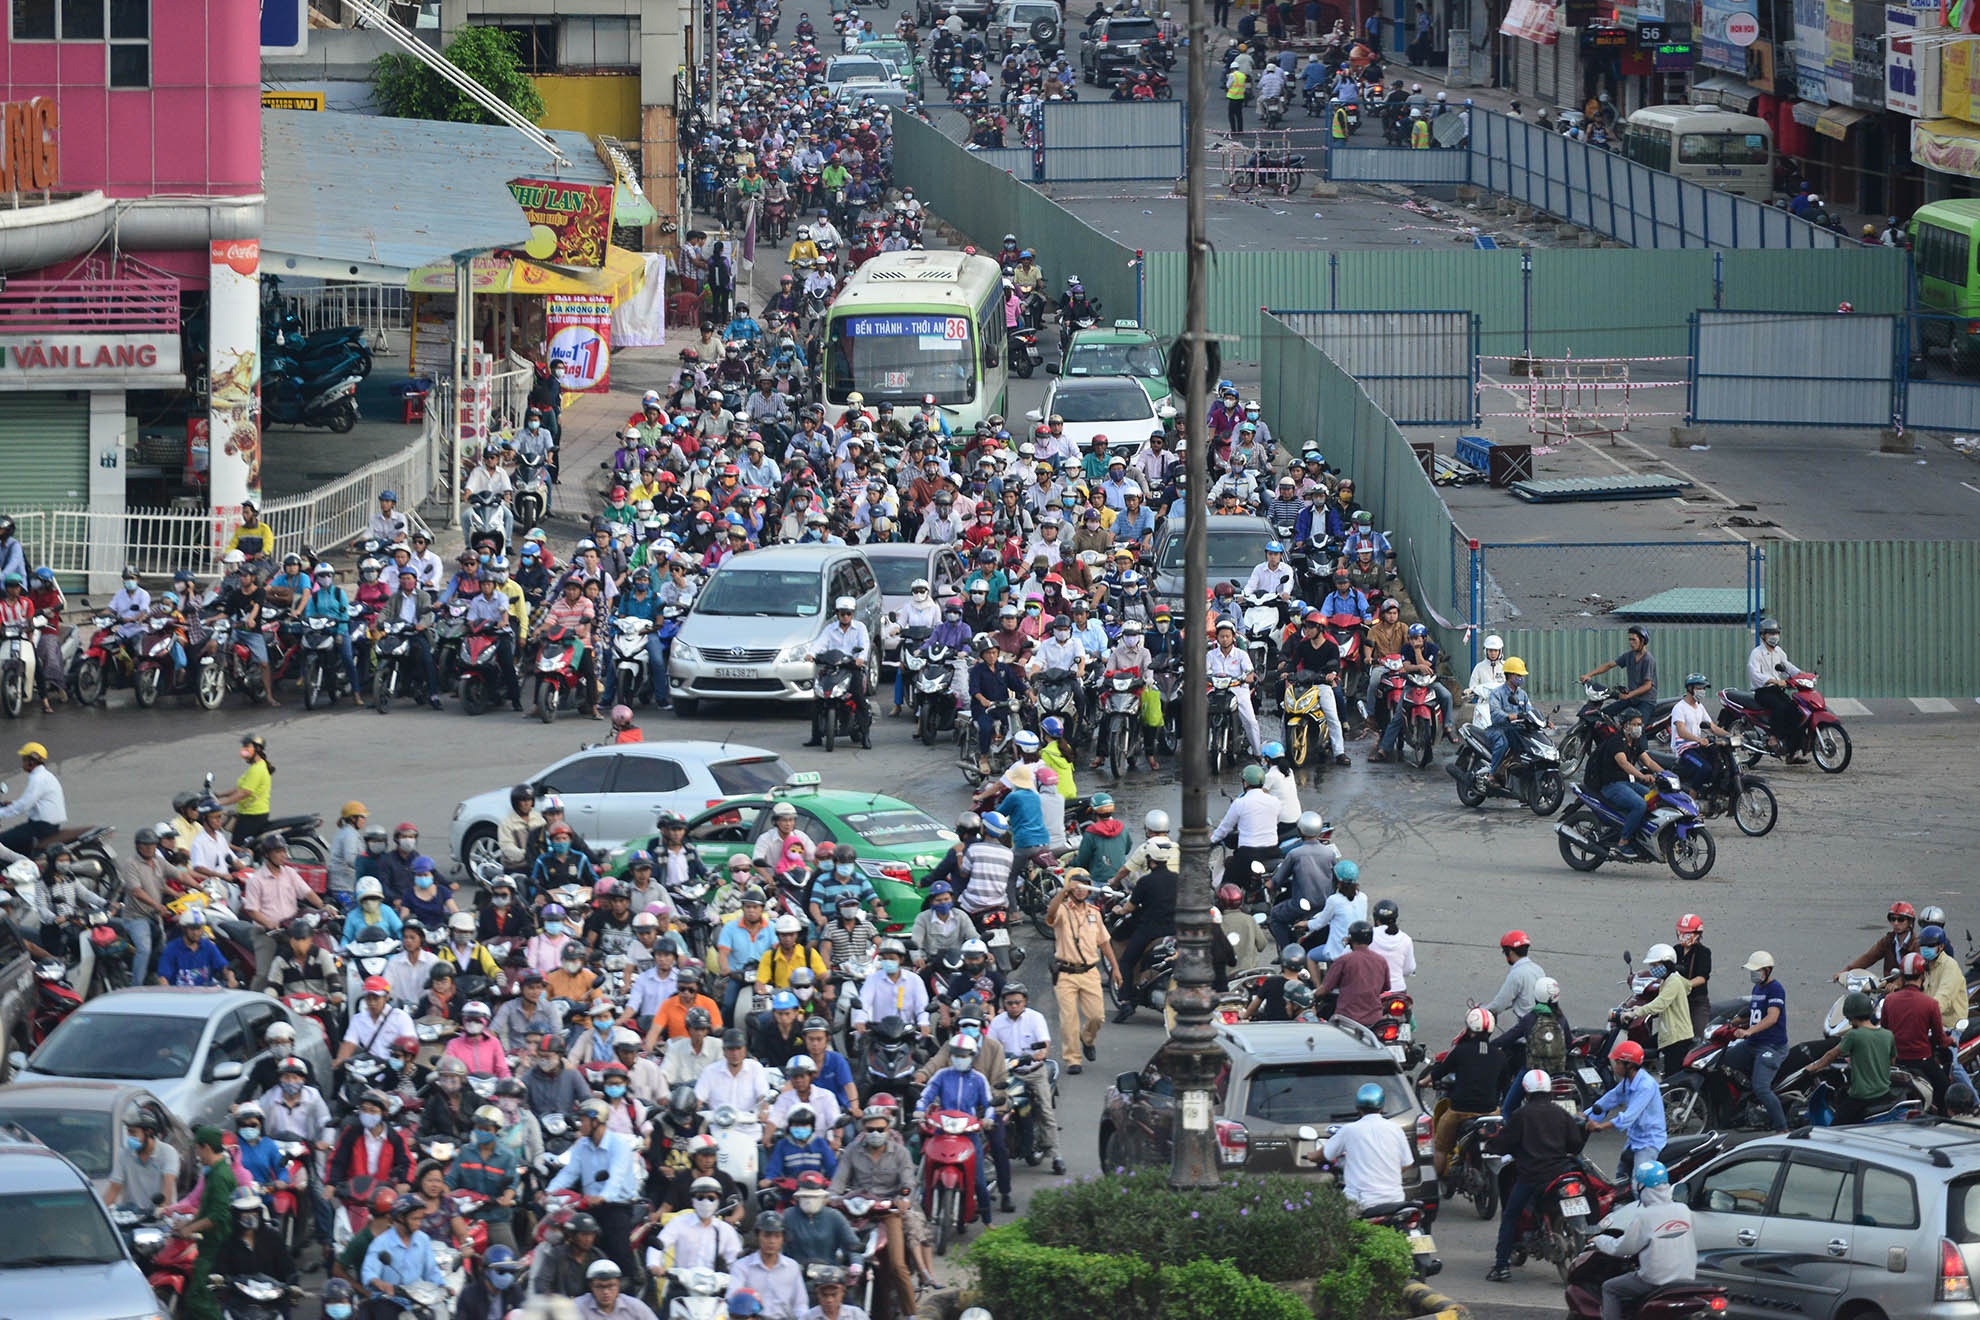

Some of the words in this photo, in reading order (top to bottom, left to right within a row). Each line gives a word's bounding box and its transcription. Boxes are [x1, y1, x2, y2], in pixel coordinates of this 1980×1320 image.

[1642, 27, 1660, 39] 56
[0, 96, 57, 192] NG
[545, 187, 586, 213] LAN
[855, 319, 872, 335] BẾN
[874, 320, 903, 335] THÀNH
[933, 320, 945, 334] AN
[946, 319, 966, 339] 36
[12, 339, 69, 368] VĂN
[74, 344, 157, 368] LANG
[551, 347, 572, 359] Mua
[572, 344, 579, 361] 1
[580, 337, 601, 380] 1
[889, 372, 905, 386] 36
